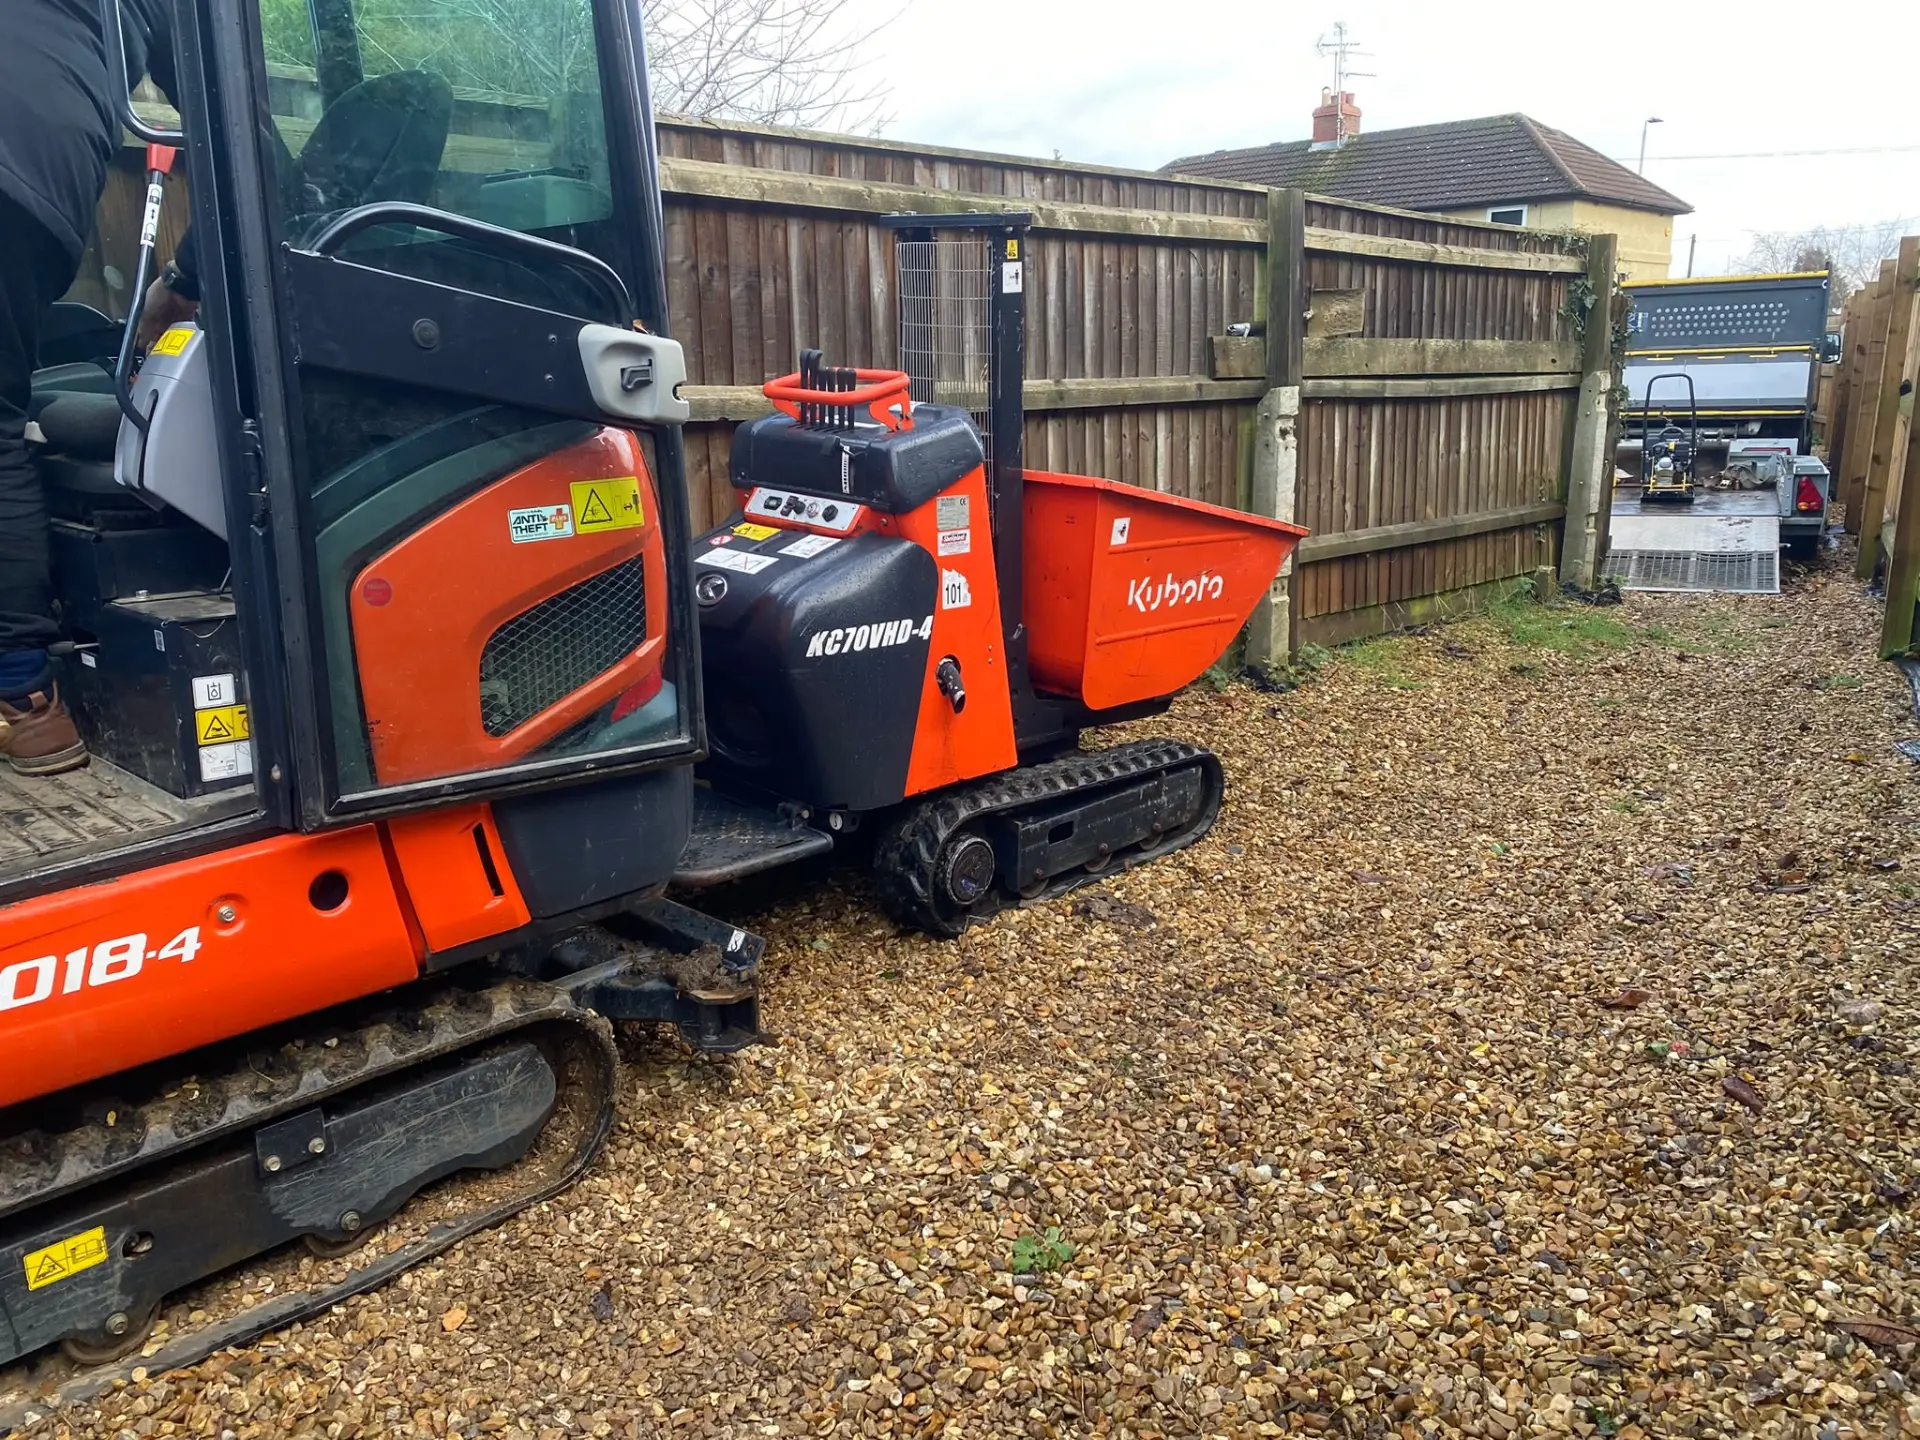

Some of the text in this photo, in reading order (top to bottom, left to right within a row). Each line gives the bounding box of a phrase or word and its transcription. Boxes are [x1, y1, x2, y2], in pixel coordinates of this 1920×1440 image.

[513, 514, 542, 525] ANTI
[513, 523, 549, 535] THEFT
[945, 582, 962, 605] 101
[1127, 573, 1223, 613] Kubota
[805, 615, 934, 657] KC70VHD-4
